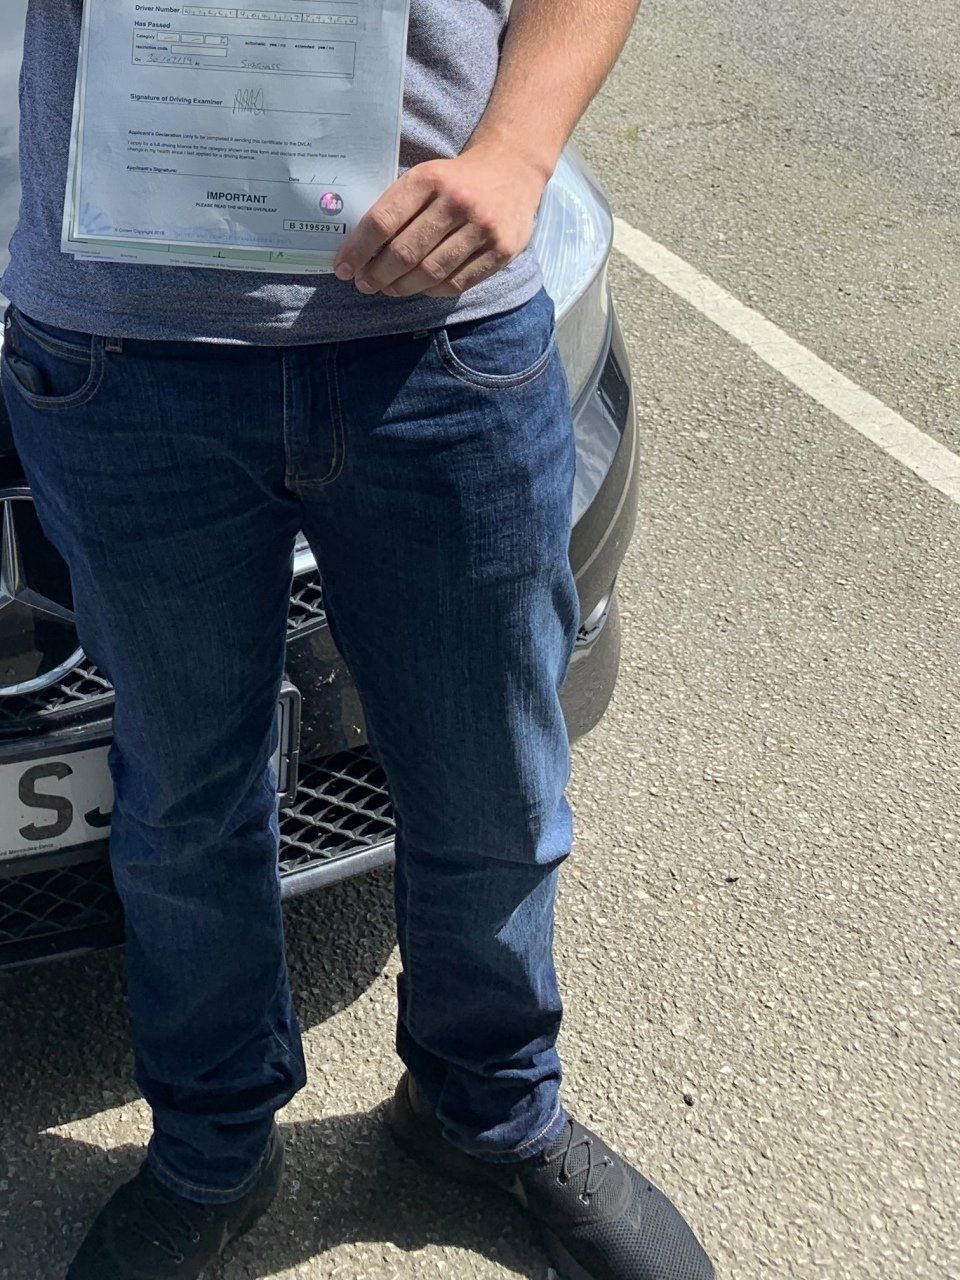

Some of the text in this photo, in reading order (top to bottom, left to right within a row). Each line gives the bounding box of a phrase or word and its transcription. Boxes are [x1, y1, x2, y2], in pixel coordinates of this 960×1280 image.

[130, 93, 160, 101] Signature
[169, 96, 192, 104] Driving
[206, 192, 268, 204] IMPORTANT
[299, 224, 331, 232] 319529
